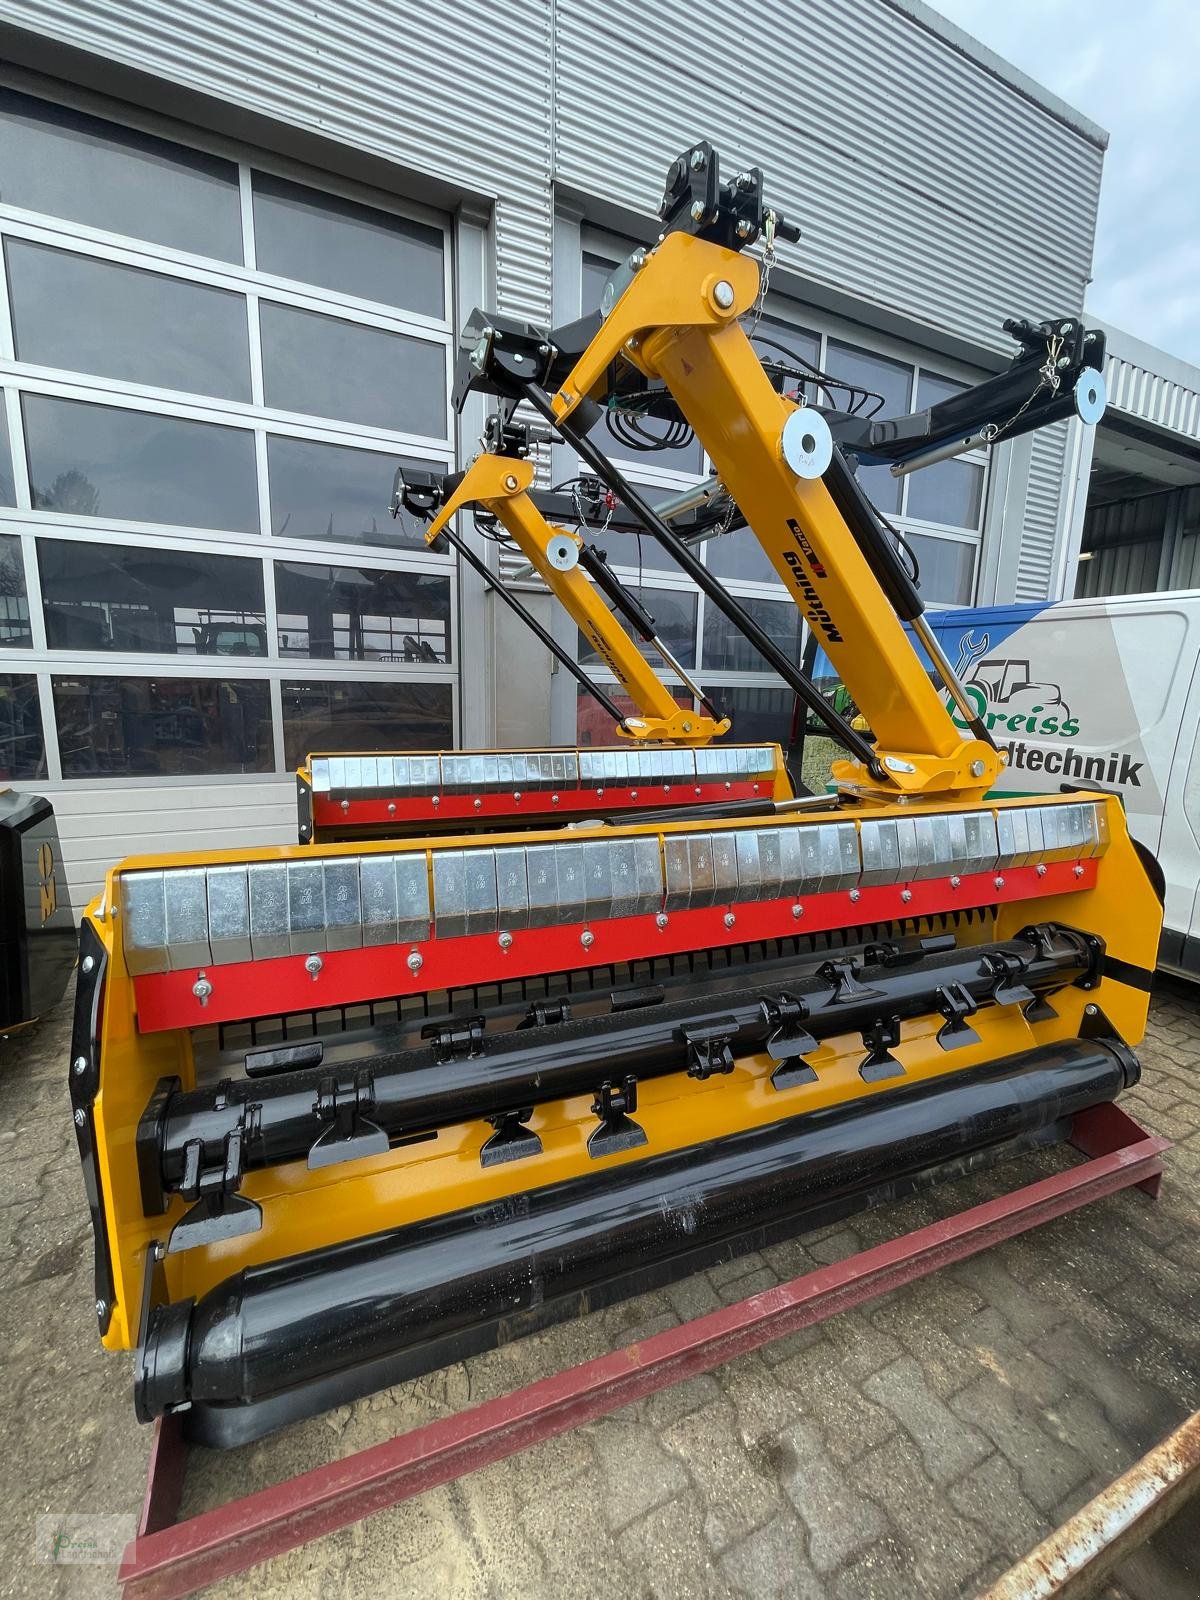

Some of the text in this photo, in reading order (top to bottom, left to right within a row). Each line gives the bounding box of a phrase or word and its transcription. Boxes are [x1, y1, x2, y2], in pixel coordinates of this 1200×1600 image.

[793, 526, 812, 556] Vario
[782, 551, 845, 643] Müthing
[997, 740, 1145, 787] dtechnik
